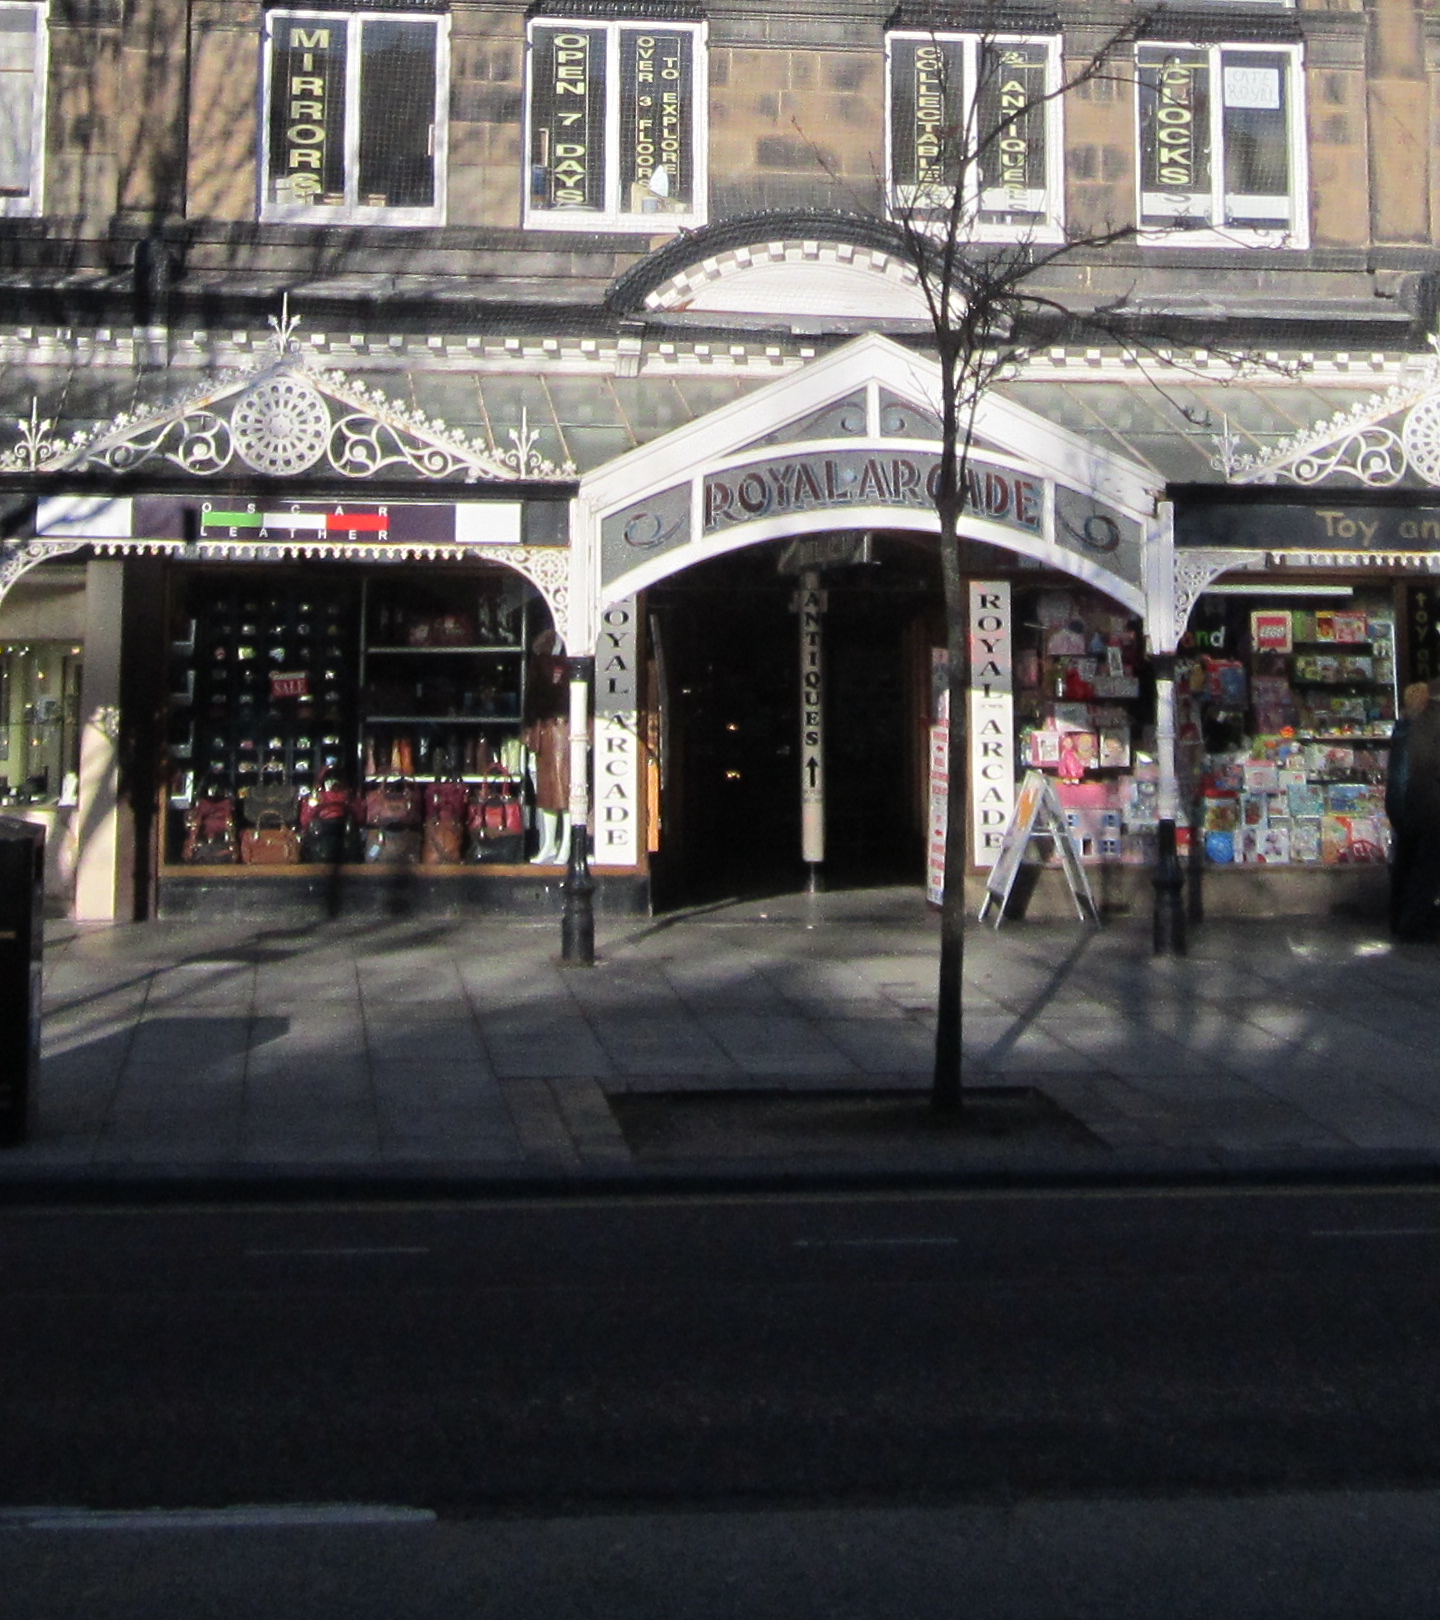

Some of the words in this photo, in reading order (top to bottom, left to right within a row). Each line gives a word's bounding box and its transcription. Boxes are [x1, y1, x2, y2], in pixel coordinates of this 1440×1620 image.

[553, 34, 587, 95] OPEN
[637, 36, 654, 82] OVER
[661, 57, 680, 80] TO
[287, 28, 330, 196] MIRRORS
[558, 113, 583, 126] 7
[639, 96, 652, 107] 3
[1157, 67, 1192, 185] CLOCKS
[661, 92, 679, 175] EXPLORE
[554, 144, 586, 202] DAYS
[201, 503, 388, 517] OSCAR
[704, 459, 853, 528] ROYAL
[200, 526, 388, 540] LEATHER
[1315, 510, 1379, 547] Toy
[604, 599, 629, 694] OYAL
[977, 593, 1004, 699] ROYAL
[1181, 626, 1227, 649] and
[273, 679, 305, 695] SALE
[804, 591, 820, 747] ANTIQUES
[604, 714, 629, 846] ARCADE
[980, 719, 1005, 849] ARCADE
